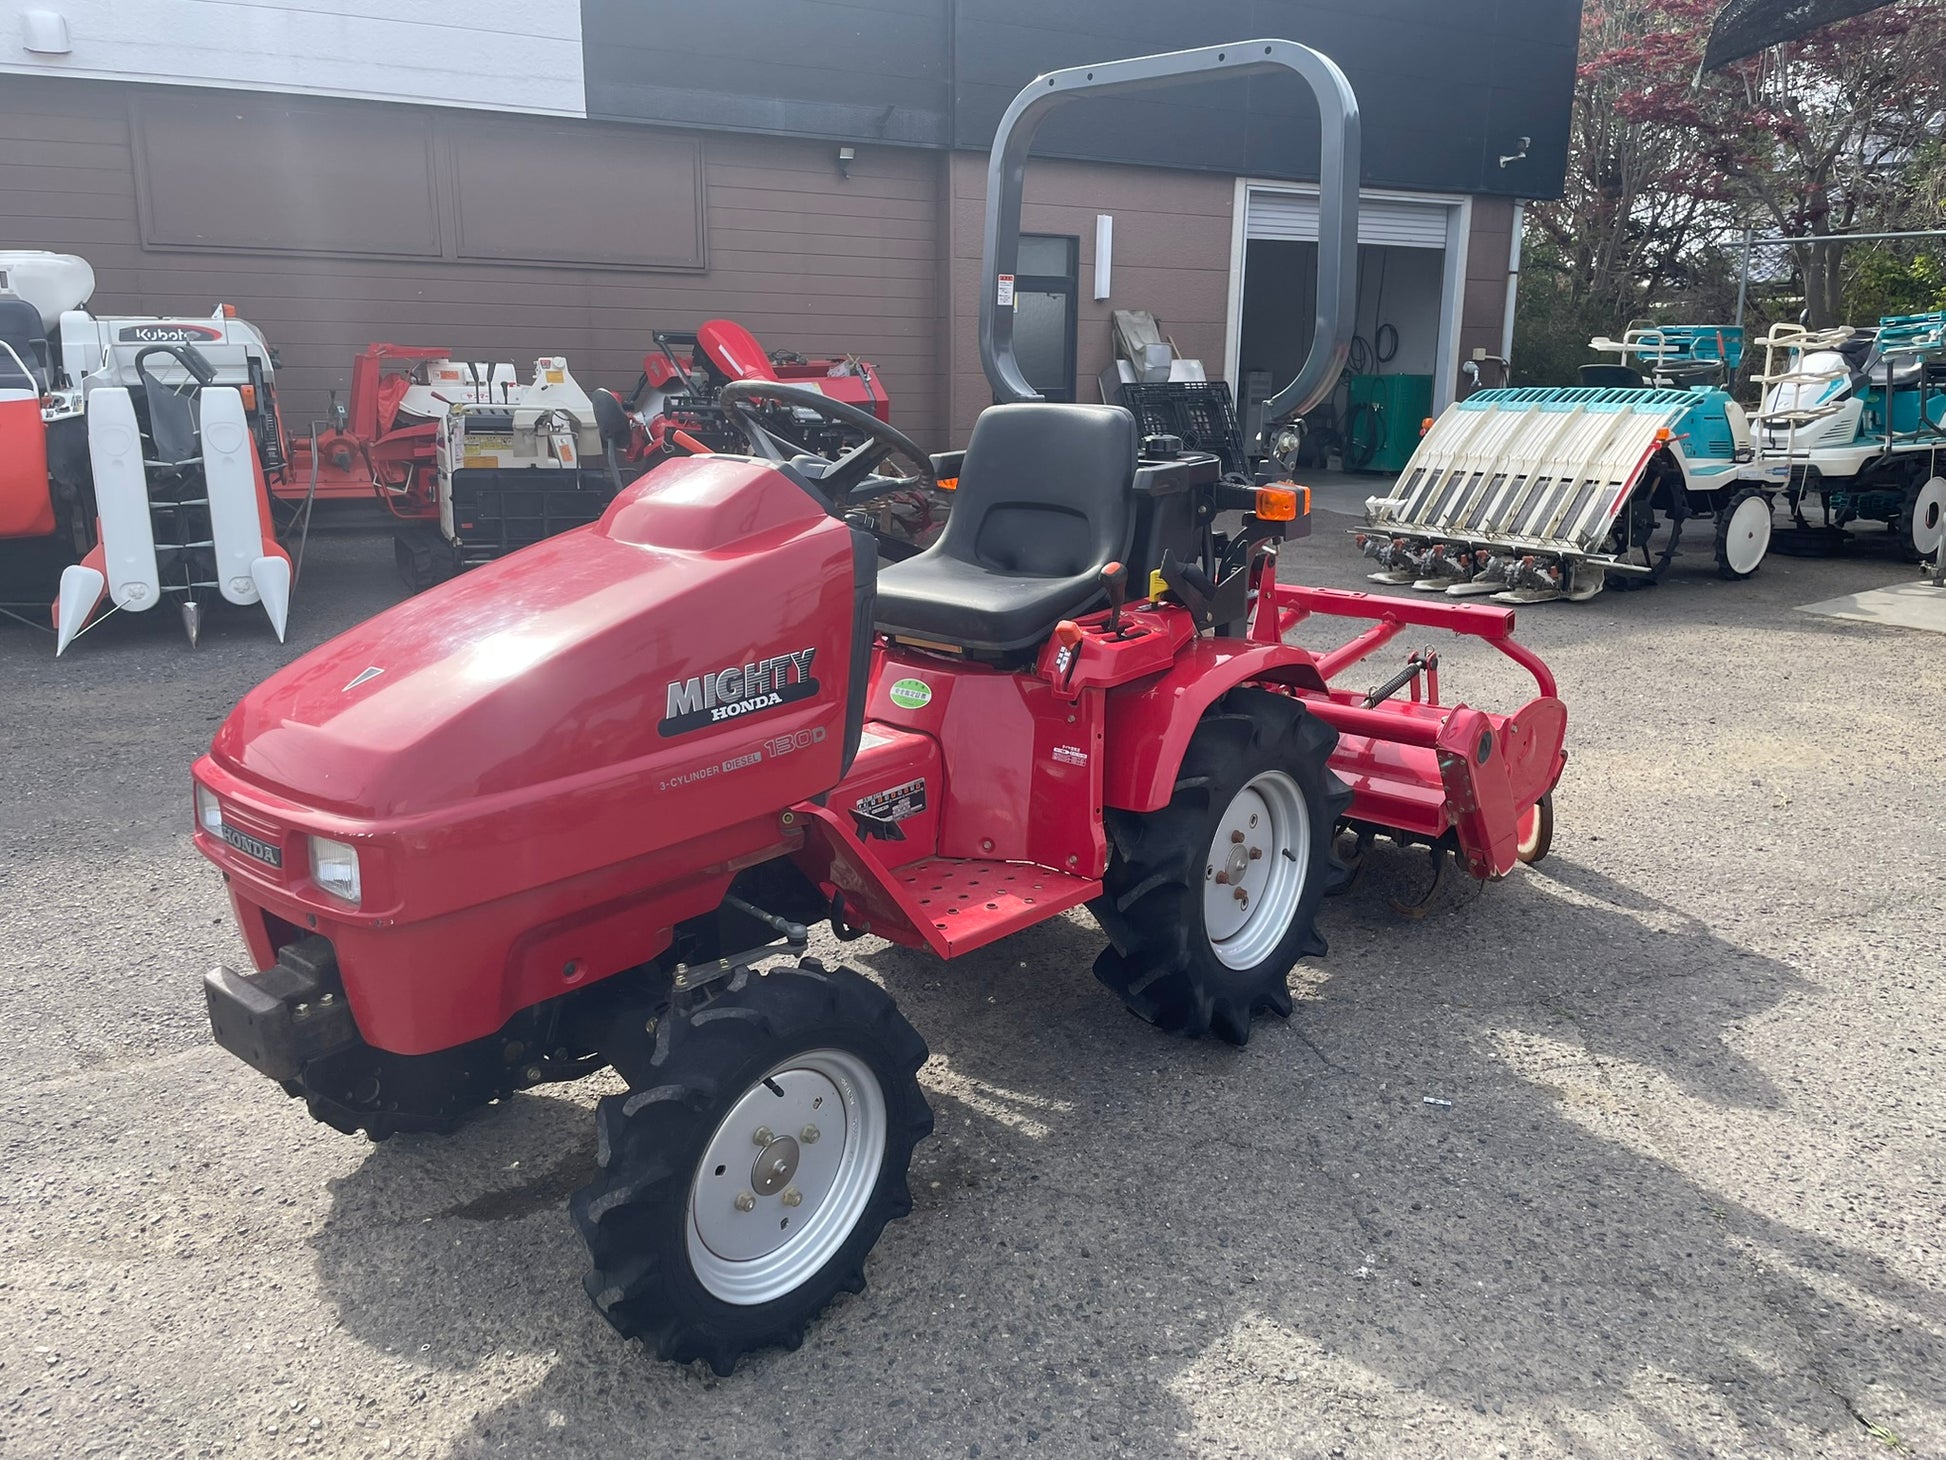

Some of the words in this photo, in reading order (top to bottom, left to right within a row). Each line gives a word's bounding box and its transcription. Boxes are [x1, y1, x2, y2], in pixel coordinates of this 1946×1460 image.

[136, 328, 190, 341] Kubot
[666, 647, 815, 720] MIGHTY
[711, 692, 783, 722] HONDA
[659, 765, 720, 791] 3-CYLINDER
[725, 753, 759, 771] DIESEL
[764, 726, 827, 758] 130D
[222, 826, 278, 865] HONDA
